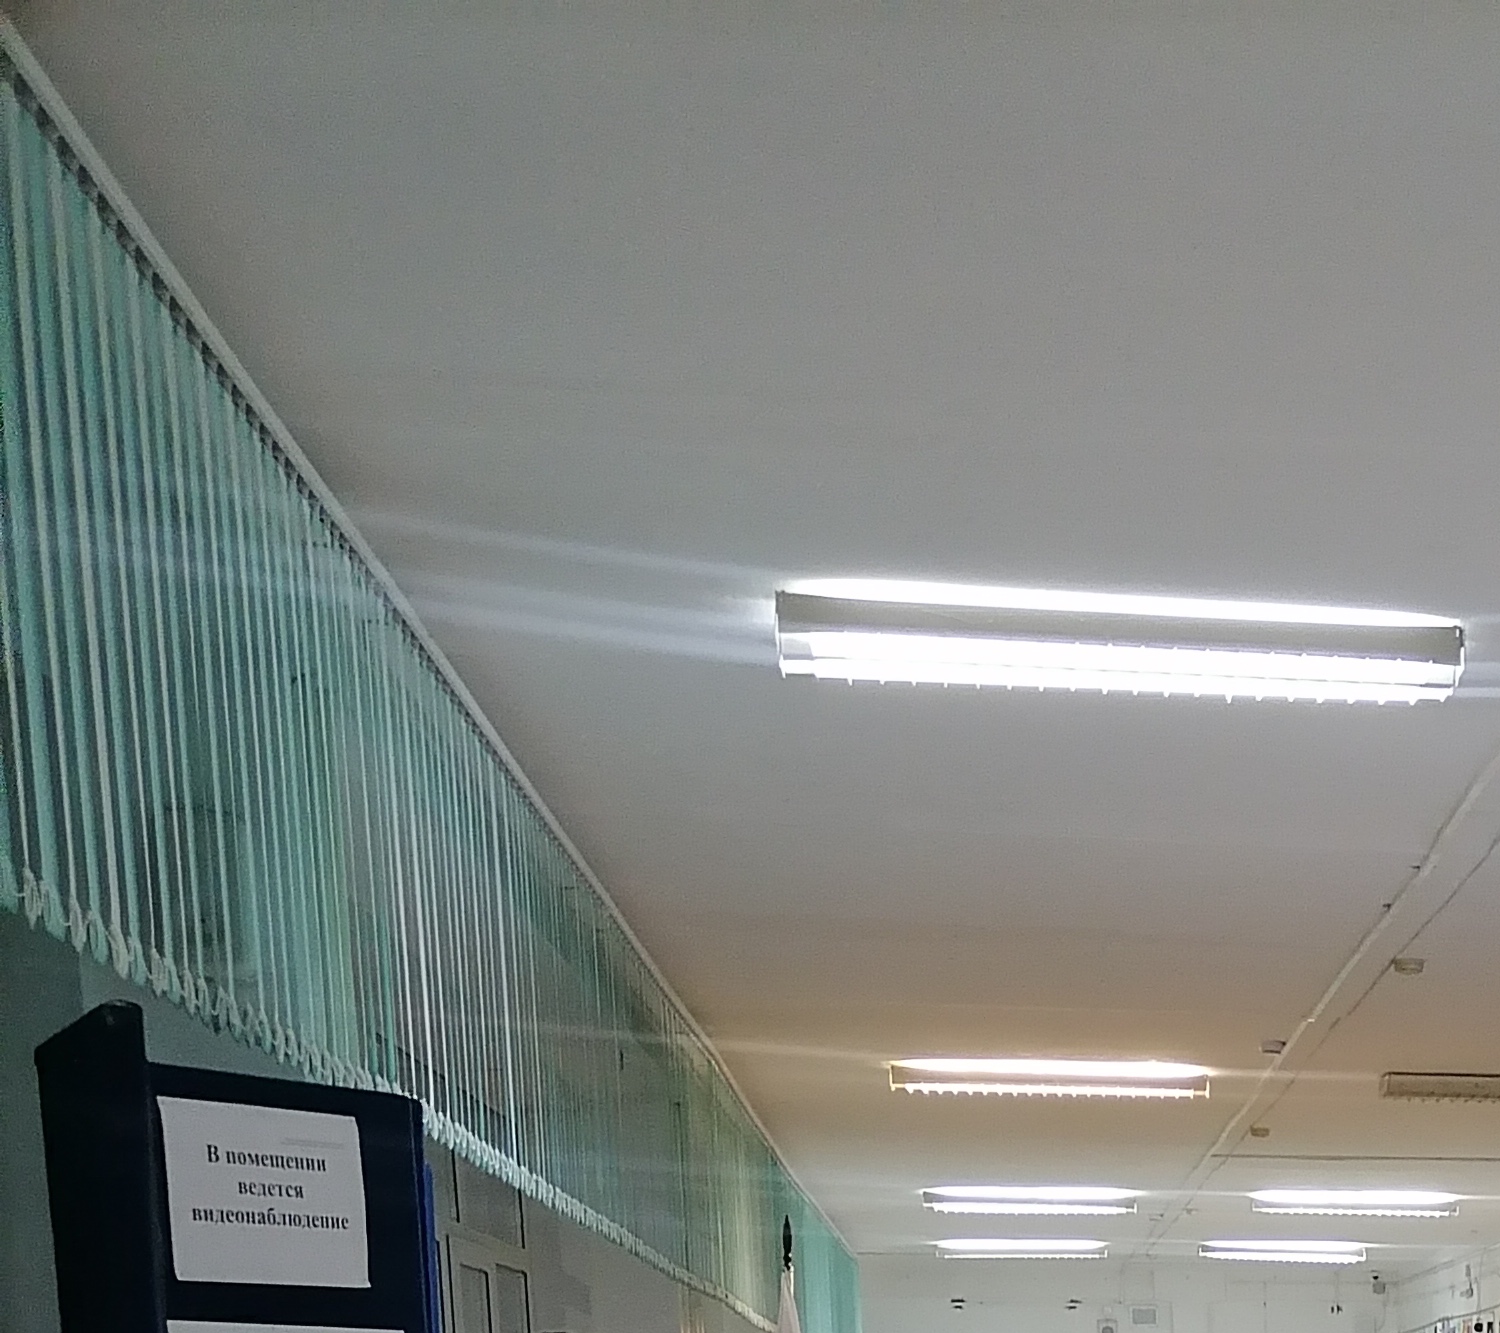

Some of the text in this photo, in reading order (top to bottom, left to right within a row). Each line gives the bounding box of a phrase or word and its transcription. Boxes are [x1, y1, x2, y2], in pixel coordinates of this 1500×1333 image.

[206, 1143, 327, 1172] В помещении
[238, 1181, 304, 1199] ведется
[191, 1207, 349, 1230] видеонаблюдение
